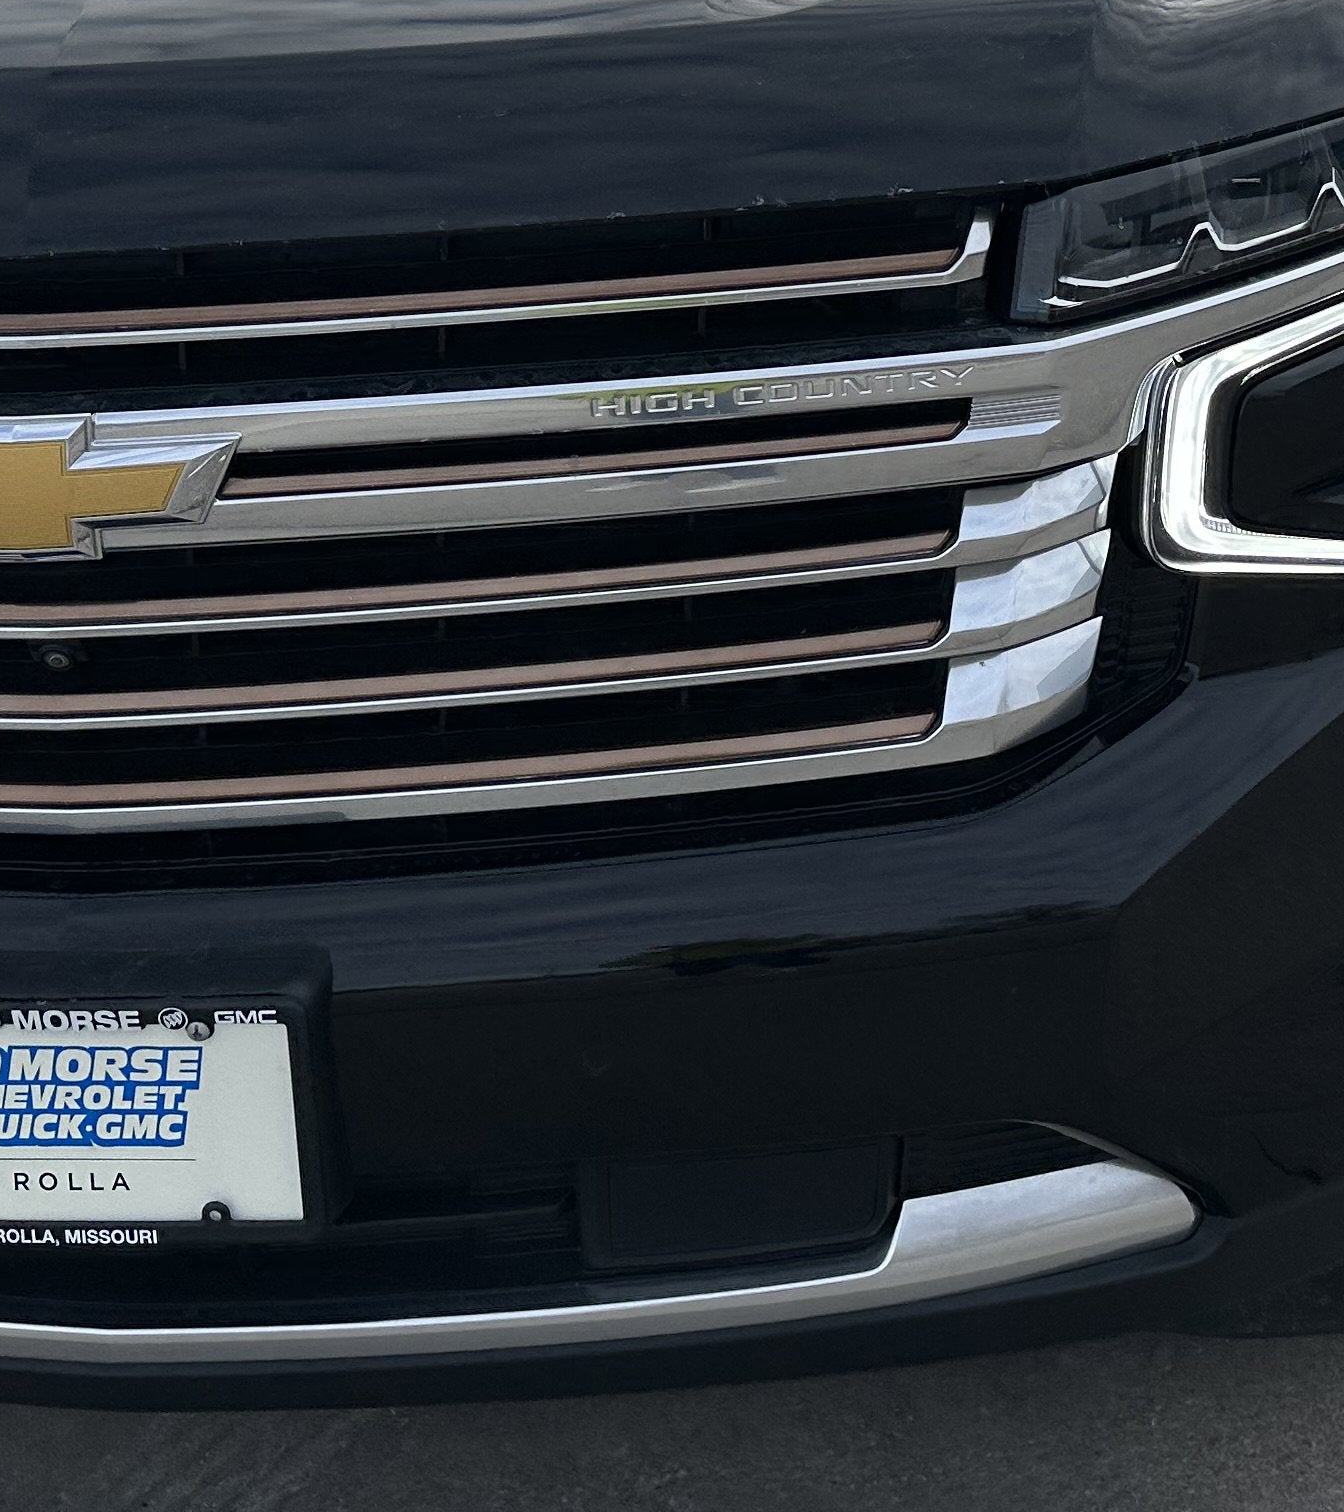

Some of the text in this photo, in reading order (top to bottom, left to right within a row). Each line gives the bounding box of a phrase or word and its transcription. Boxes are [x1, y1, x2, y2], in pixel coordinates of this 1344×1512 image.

[591, 366, 975, 417] HIGH COUNTRY
[11, 1009, 142, 1032] MORSE
[213, 1009, 277, 1024] GMC
[7, 1048, 200, 1082] MORSE
[13, 1172, 131, 1191] ROLLA
[64, 1229, 158, 1245] MISSOURI
